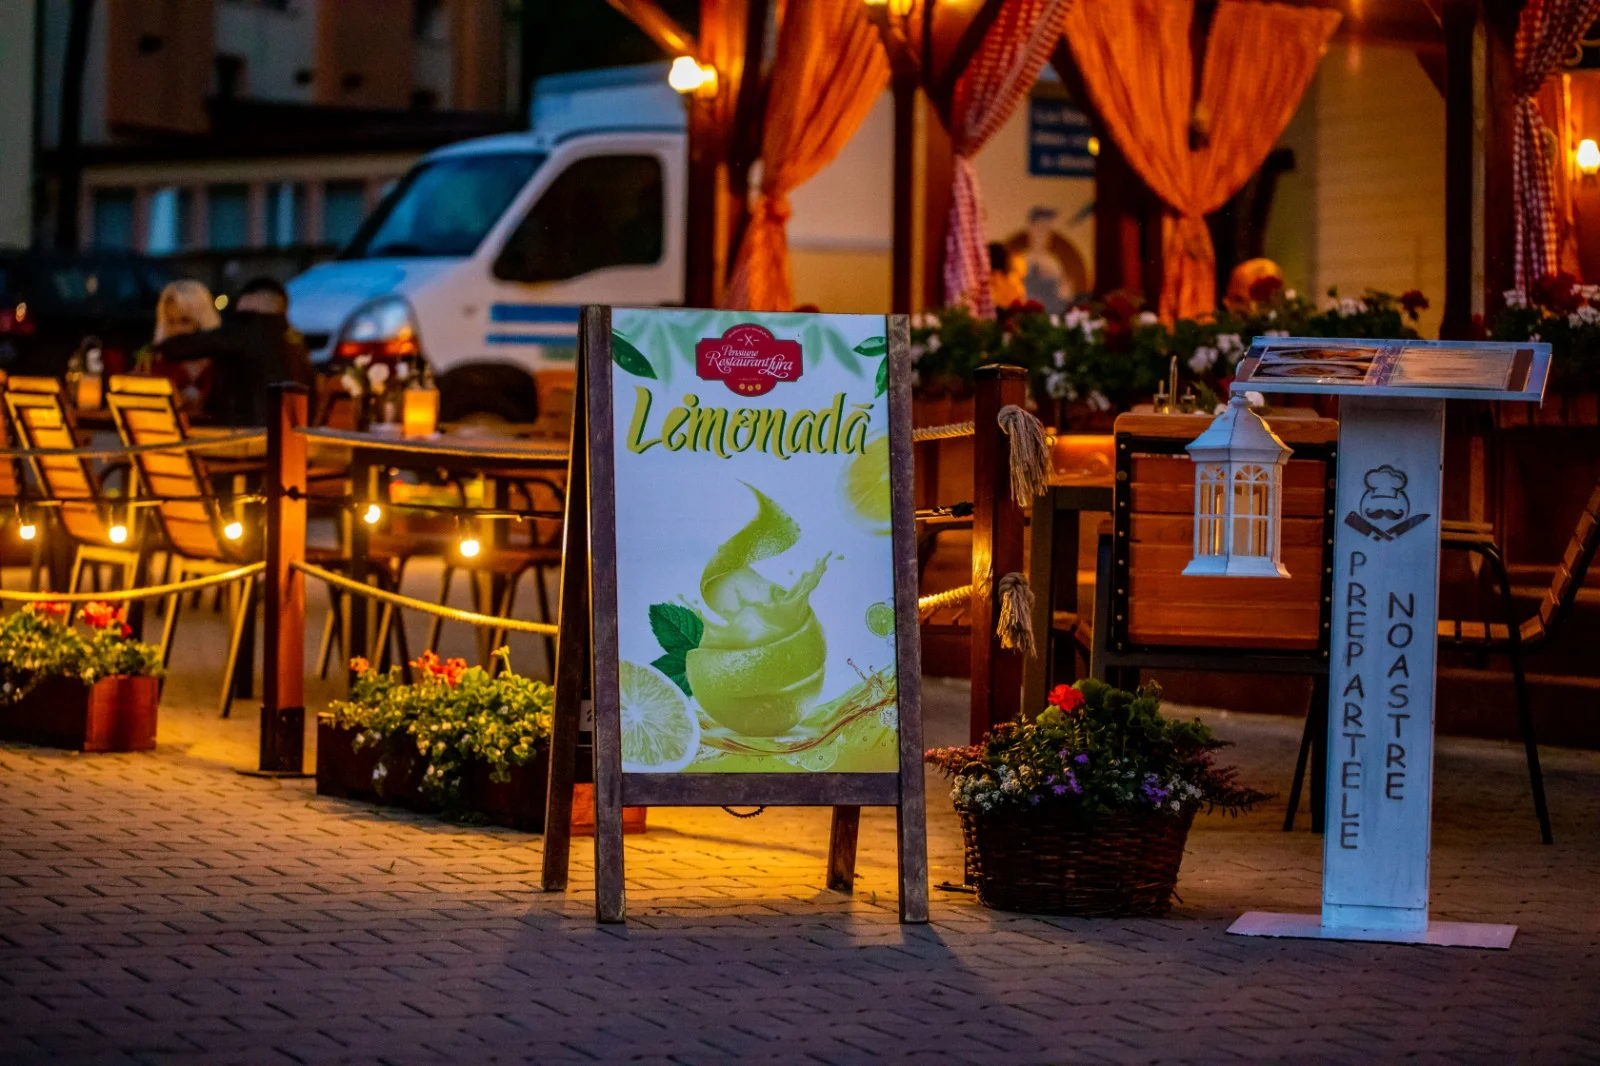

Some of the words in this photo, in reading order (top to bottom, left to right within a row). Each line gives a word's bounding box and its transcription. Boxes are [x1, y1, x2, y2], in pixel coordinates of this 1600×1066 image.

[705, 351, 769, 374] Restaurant
[758, 354, 794, 378] Lyra
[721, 344, 759, 356] Pensiune
[1340, 551, 1367, 849] PREPARTELE
[1386, 591, 1414, 800] NOASTRE
